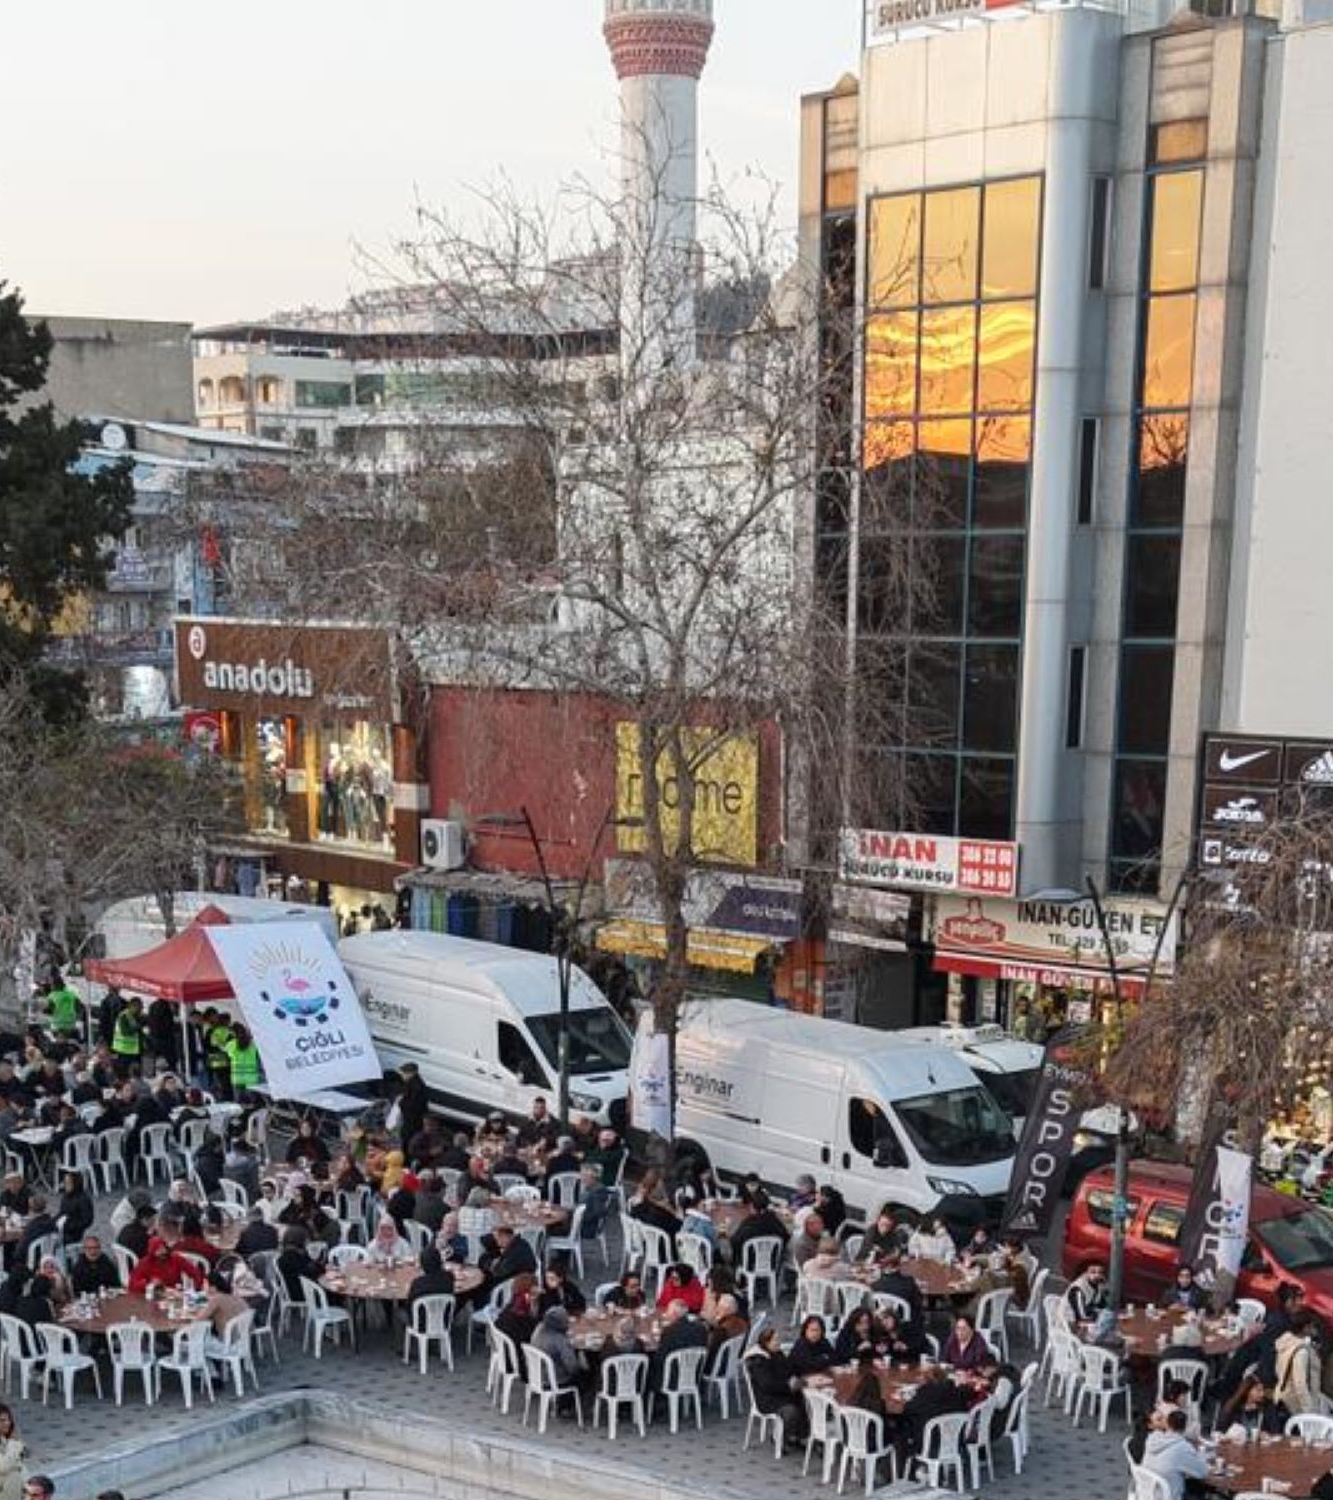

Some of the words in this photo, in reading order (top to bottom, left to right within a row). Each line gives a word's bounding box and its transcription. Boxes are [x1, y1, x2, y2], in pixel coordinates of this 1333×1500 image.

[204, 658, 314, 698] anadolu
[675, 1065, 734, 1097] Enginar
[1022, 1088, 1073, 1208] SPOR
